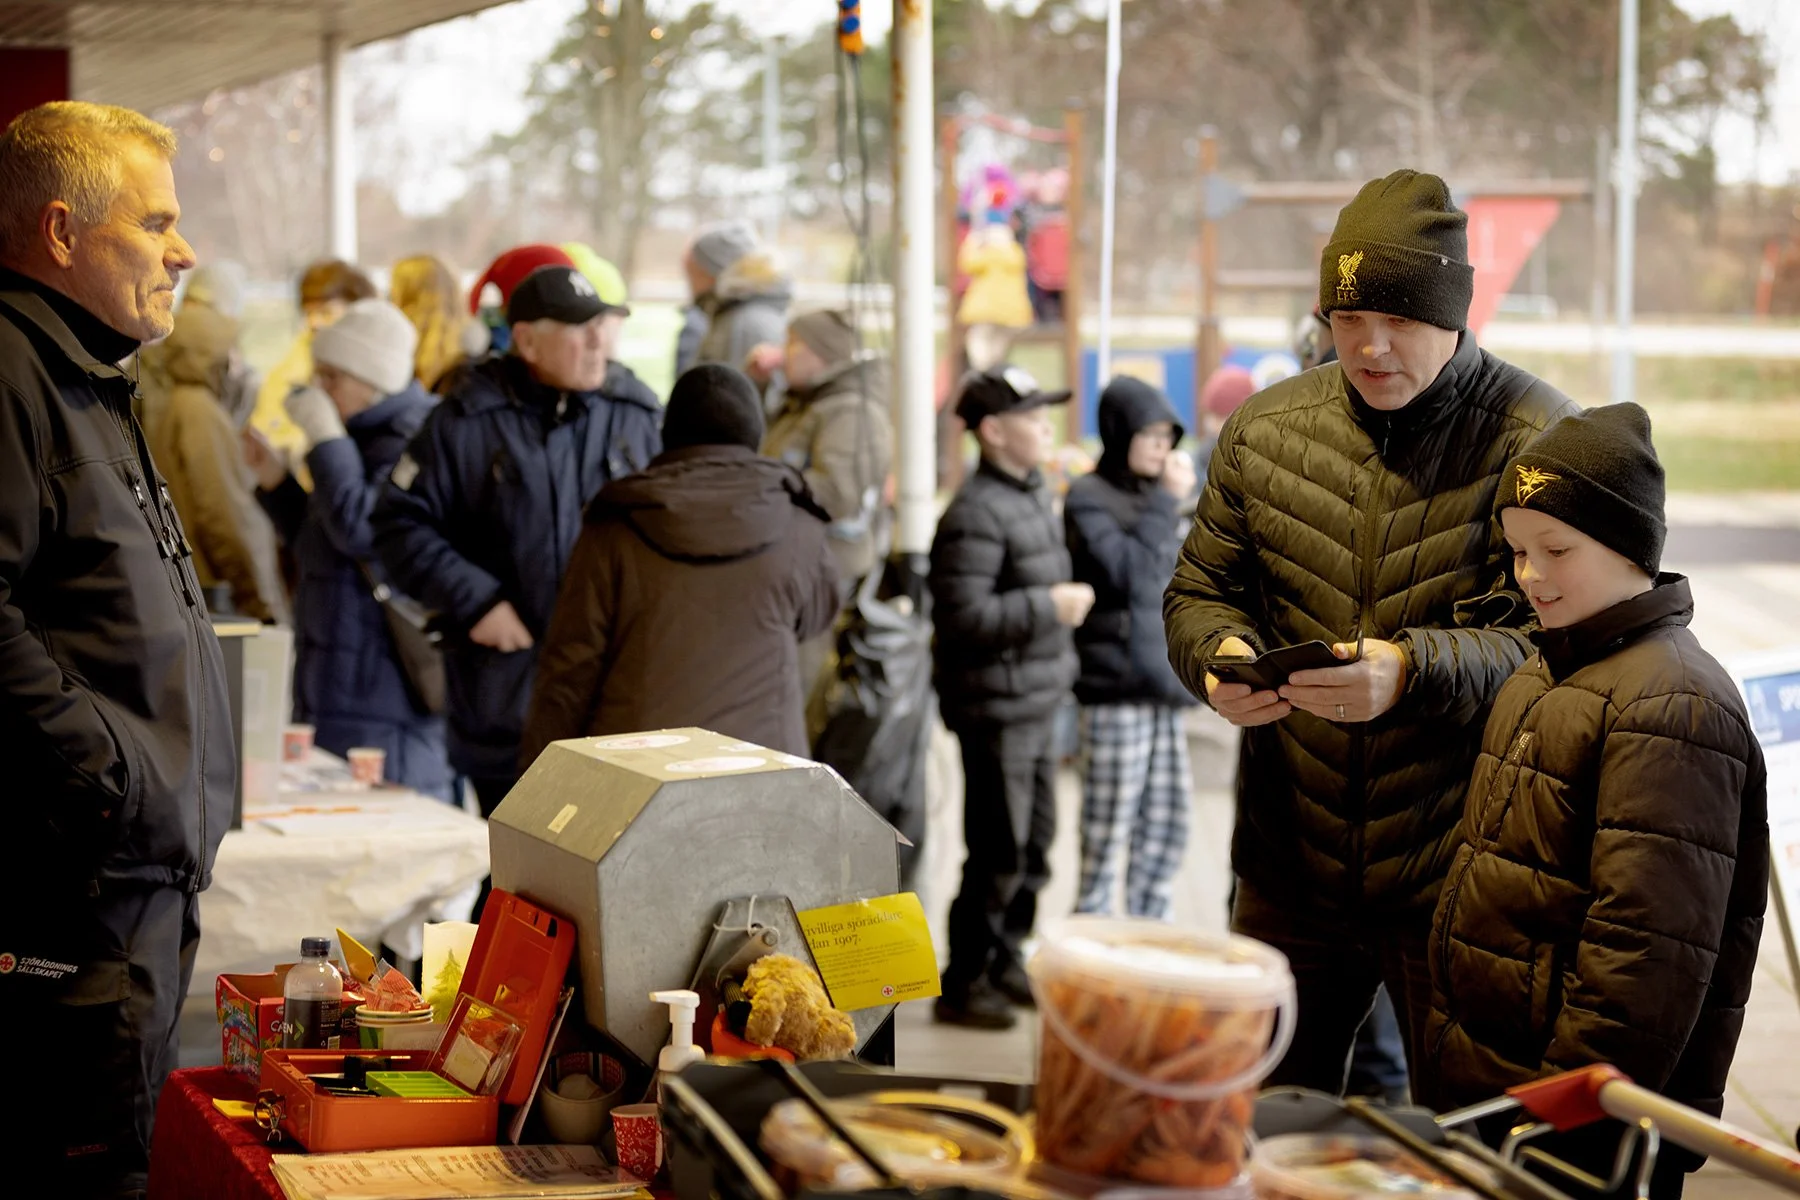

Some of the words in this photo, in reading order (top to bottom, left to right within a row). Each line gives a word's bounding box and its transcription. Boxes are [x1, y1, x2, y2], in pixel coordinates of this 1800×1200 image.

[1336, 289, 1360, 301] LFC
[804, 921, 844, 936] ivilliga
[834, 934, 862, 948] 1907.
[16, 964, 65, 979] SÄLLSKAPET
[20, 957, 78, 973] SJÖRÄDDNINGS
